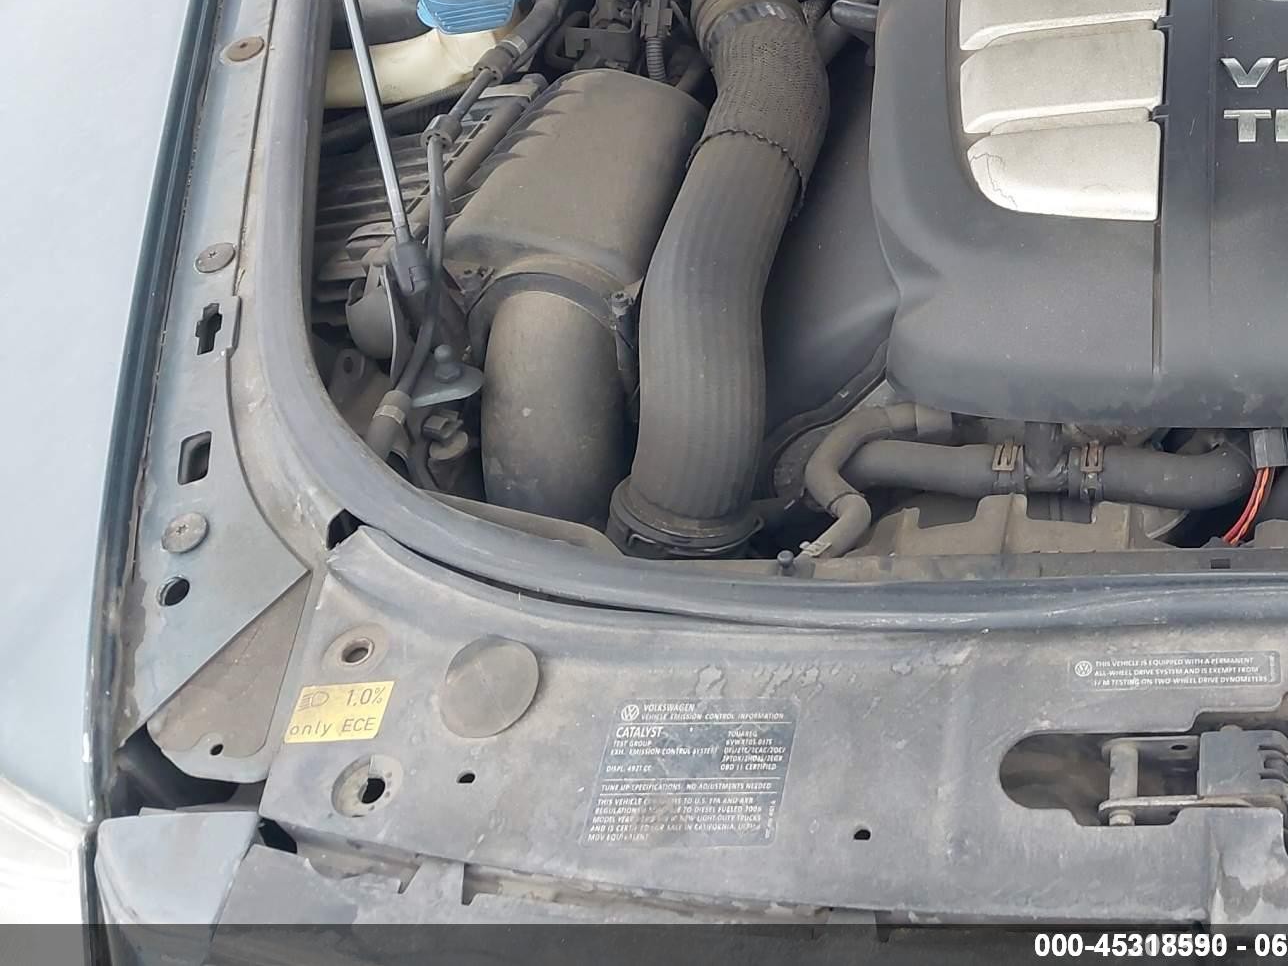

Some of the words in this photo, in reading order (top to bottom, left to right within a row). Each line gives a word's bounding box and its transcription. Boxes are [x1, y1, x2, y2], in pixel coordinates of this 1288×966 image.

[1113, 659, 1139, 667] VEHICLE
[1211, 657, 1254, 665] PERMANENT
[1112, 679, 1139, 687] TESTING
[347, 686, 387, 707] 1.0%
[643, 704, 695, 712] VOLKSWAGEN
[737, 712, 785, 720] INFORMATION
[289, 720, 333, 738] only
[341, 717, 377, 733] ECE
[616, 726, 664, 738] CATALYST
[661, 747, 691, 755] CONTROL
[745, 762, 777, 770] CERTIFIED
[615, 797, 643, 805] VEHICLE
